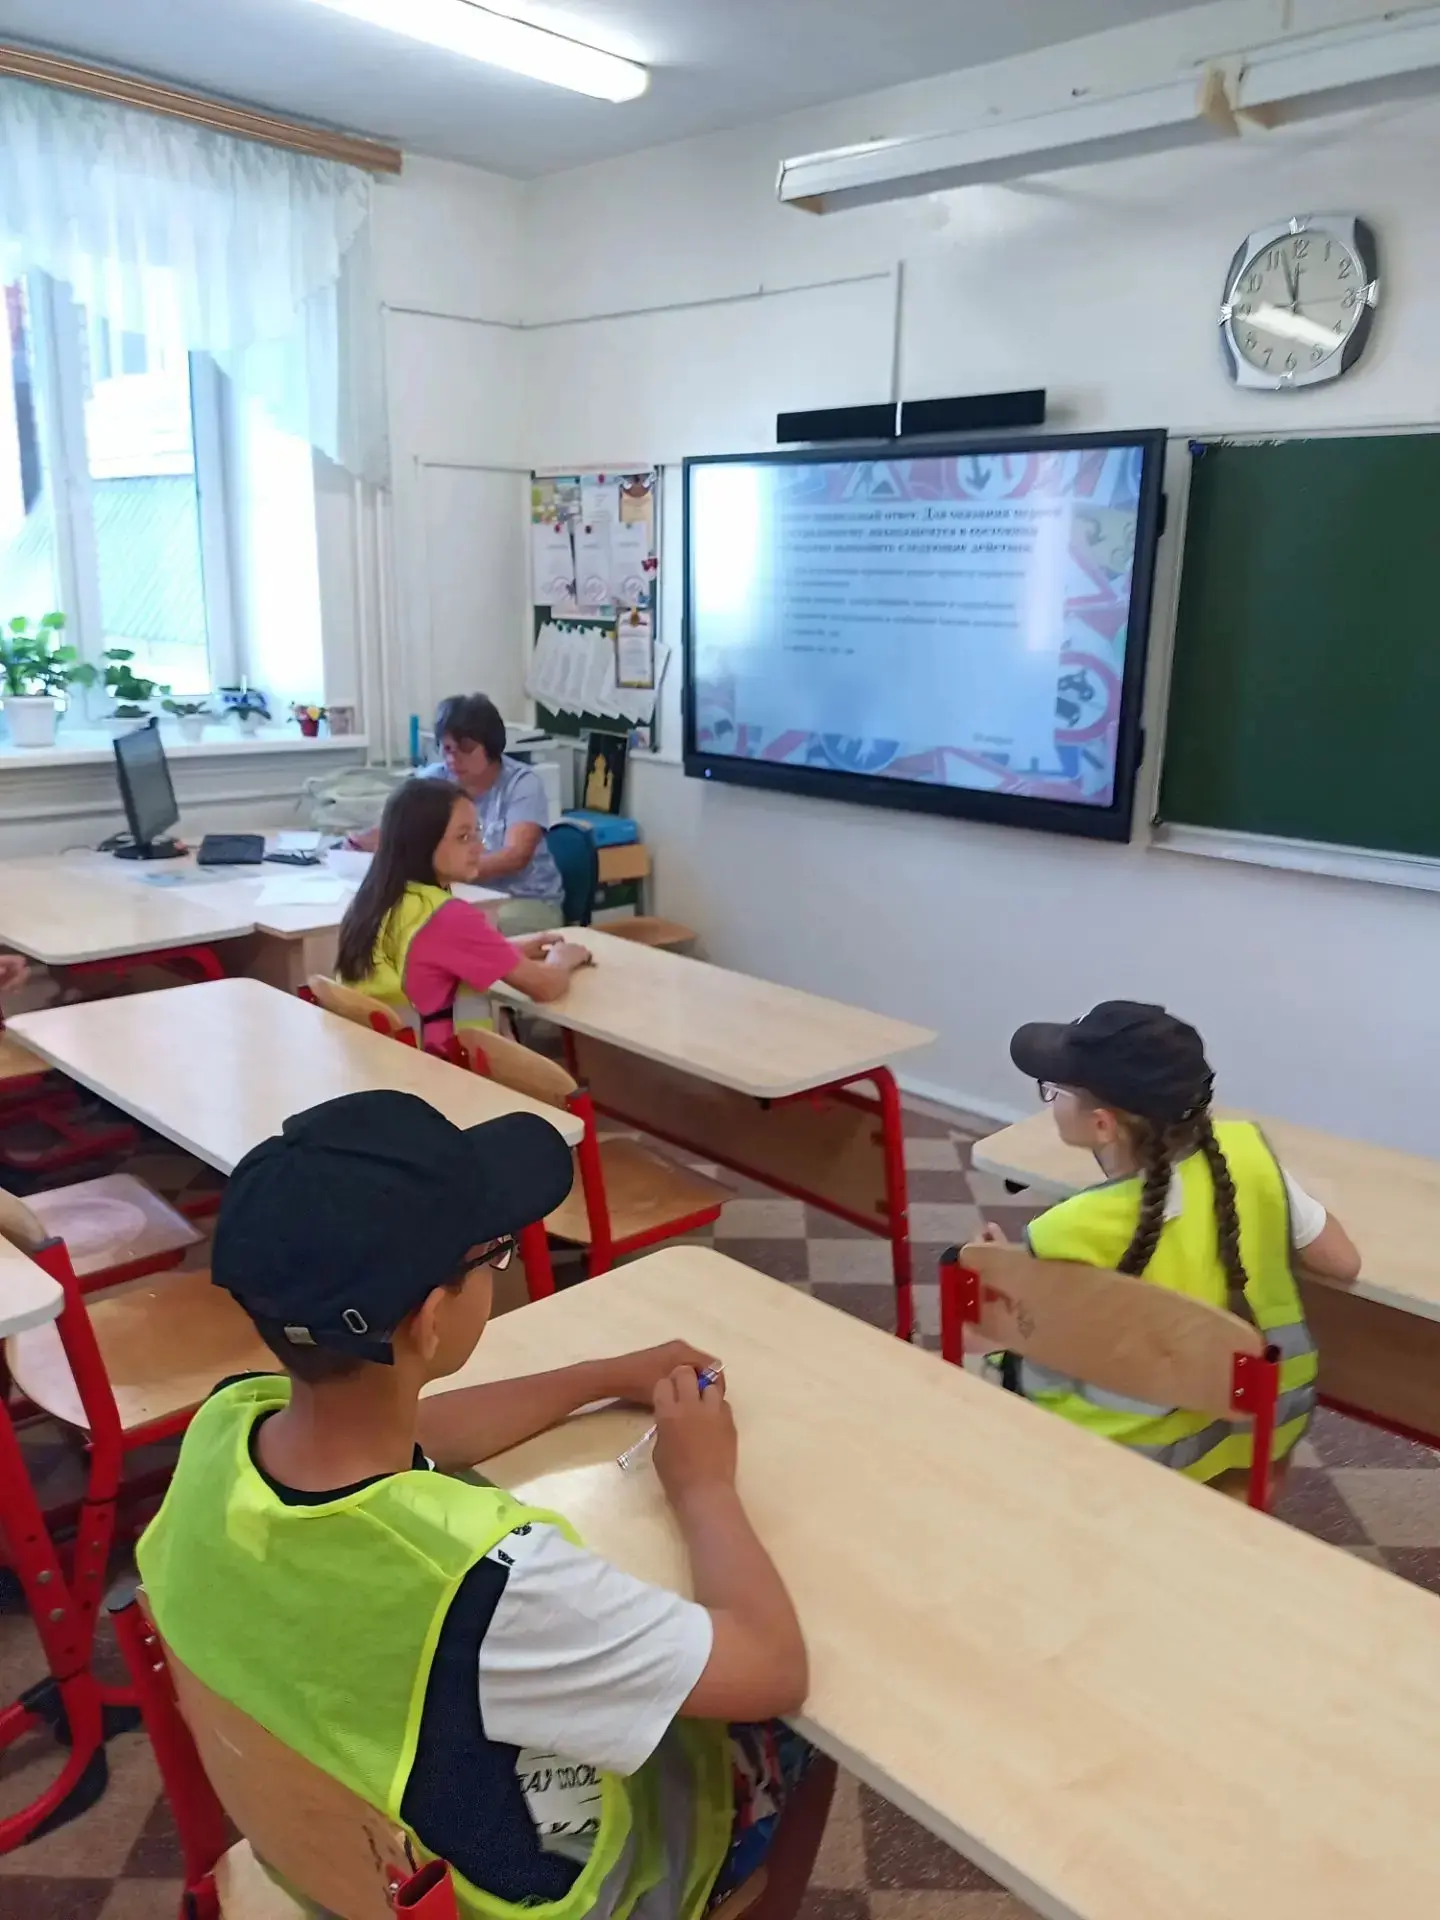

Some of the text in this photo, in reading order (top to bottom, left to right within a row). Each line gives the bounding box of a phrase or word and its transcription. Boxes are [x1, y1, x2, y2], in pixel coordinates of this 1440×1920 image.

[1293, 239, 1310, 259] 12
[1266, 250, 1280, 271] 11
[1338, 258, 1351, 280] 2
[1246, 273, 1263, 294] 10
[1263, 348, 1274, 368] 7
[1285, 352, 1297, 371] 6
